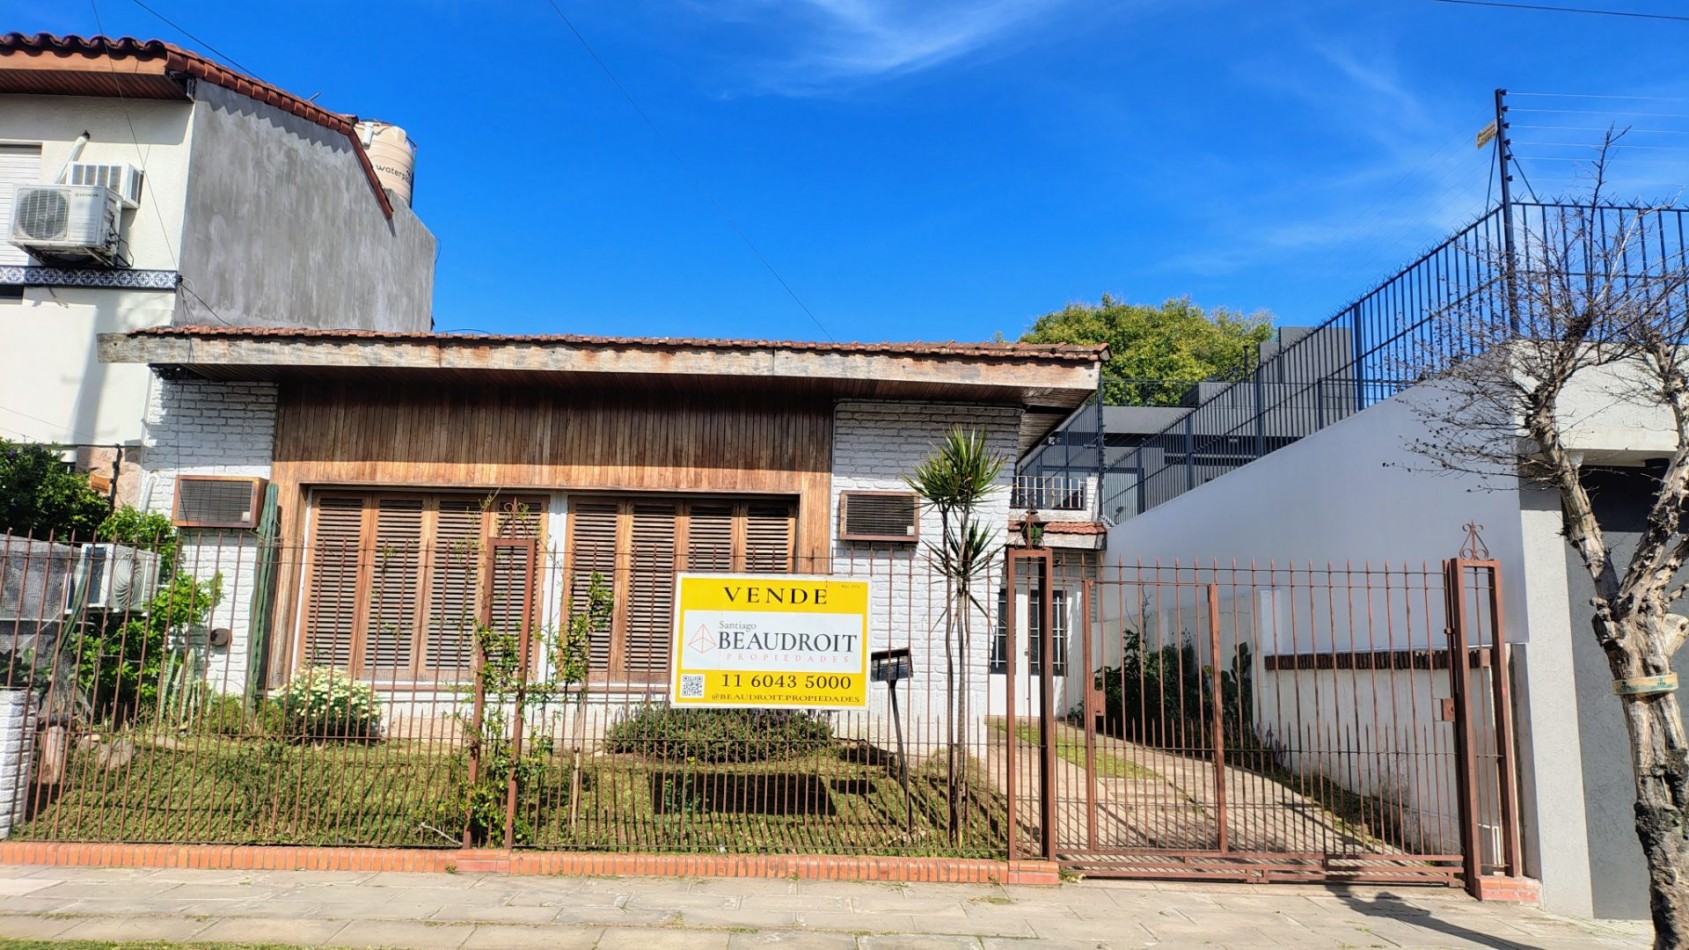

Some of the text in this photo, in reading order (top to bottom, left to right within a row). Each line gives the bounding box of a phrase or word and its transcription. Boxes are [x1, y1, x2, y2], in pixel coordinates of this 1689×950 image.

[723, 586, 827, 605] VENDE
[719, 620, 756, 632] Santiago
[718, 631, 858, 653] BEAUDROIT
[726, 653, 850, 663] PROPIEDADES
[722, 674, 852, 690] 11 6043 5000
[711, 693, 861, 703] @BEAUDROIT.PROPIEDADES
